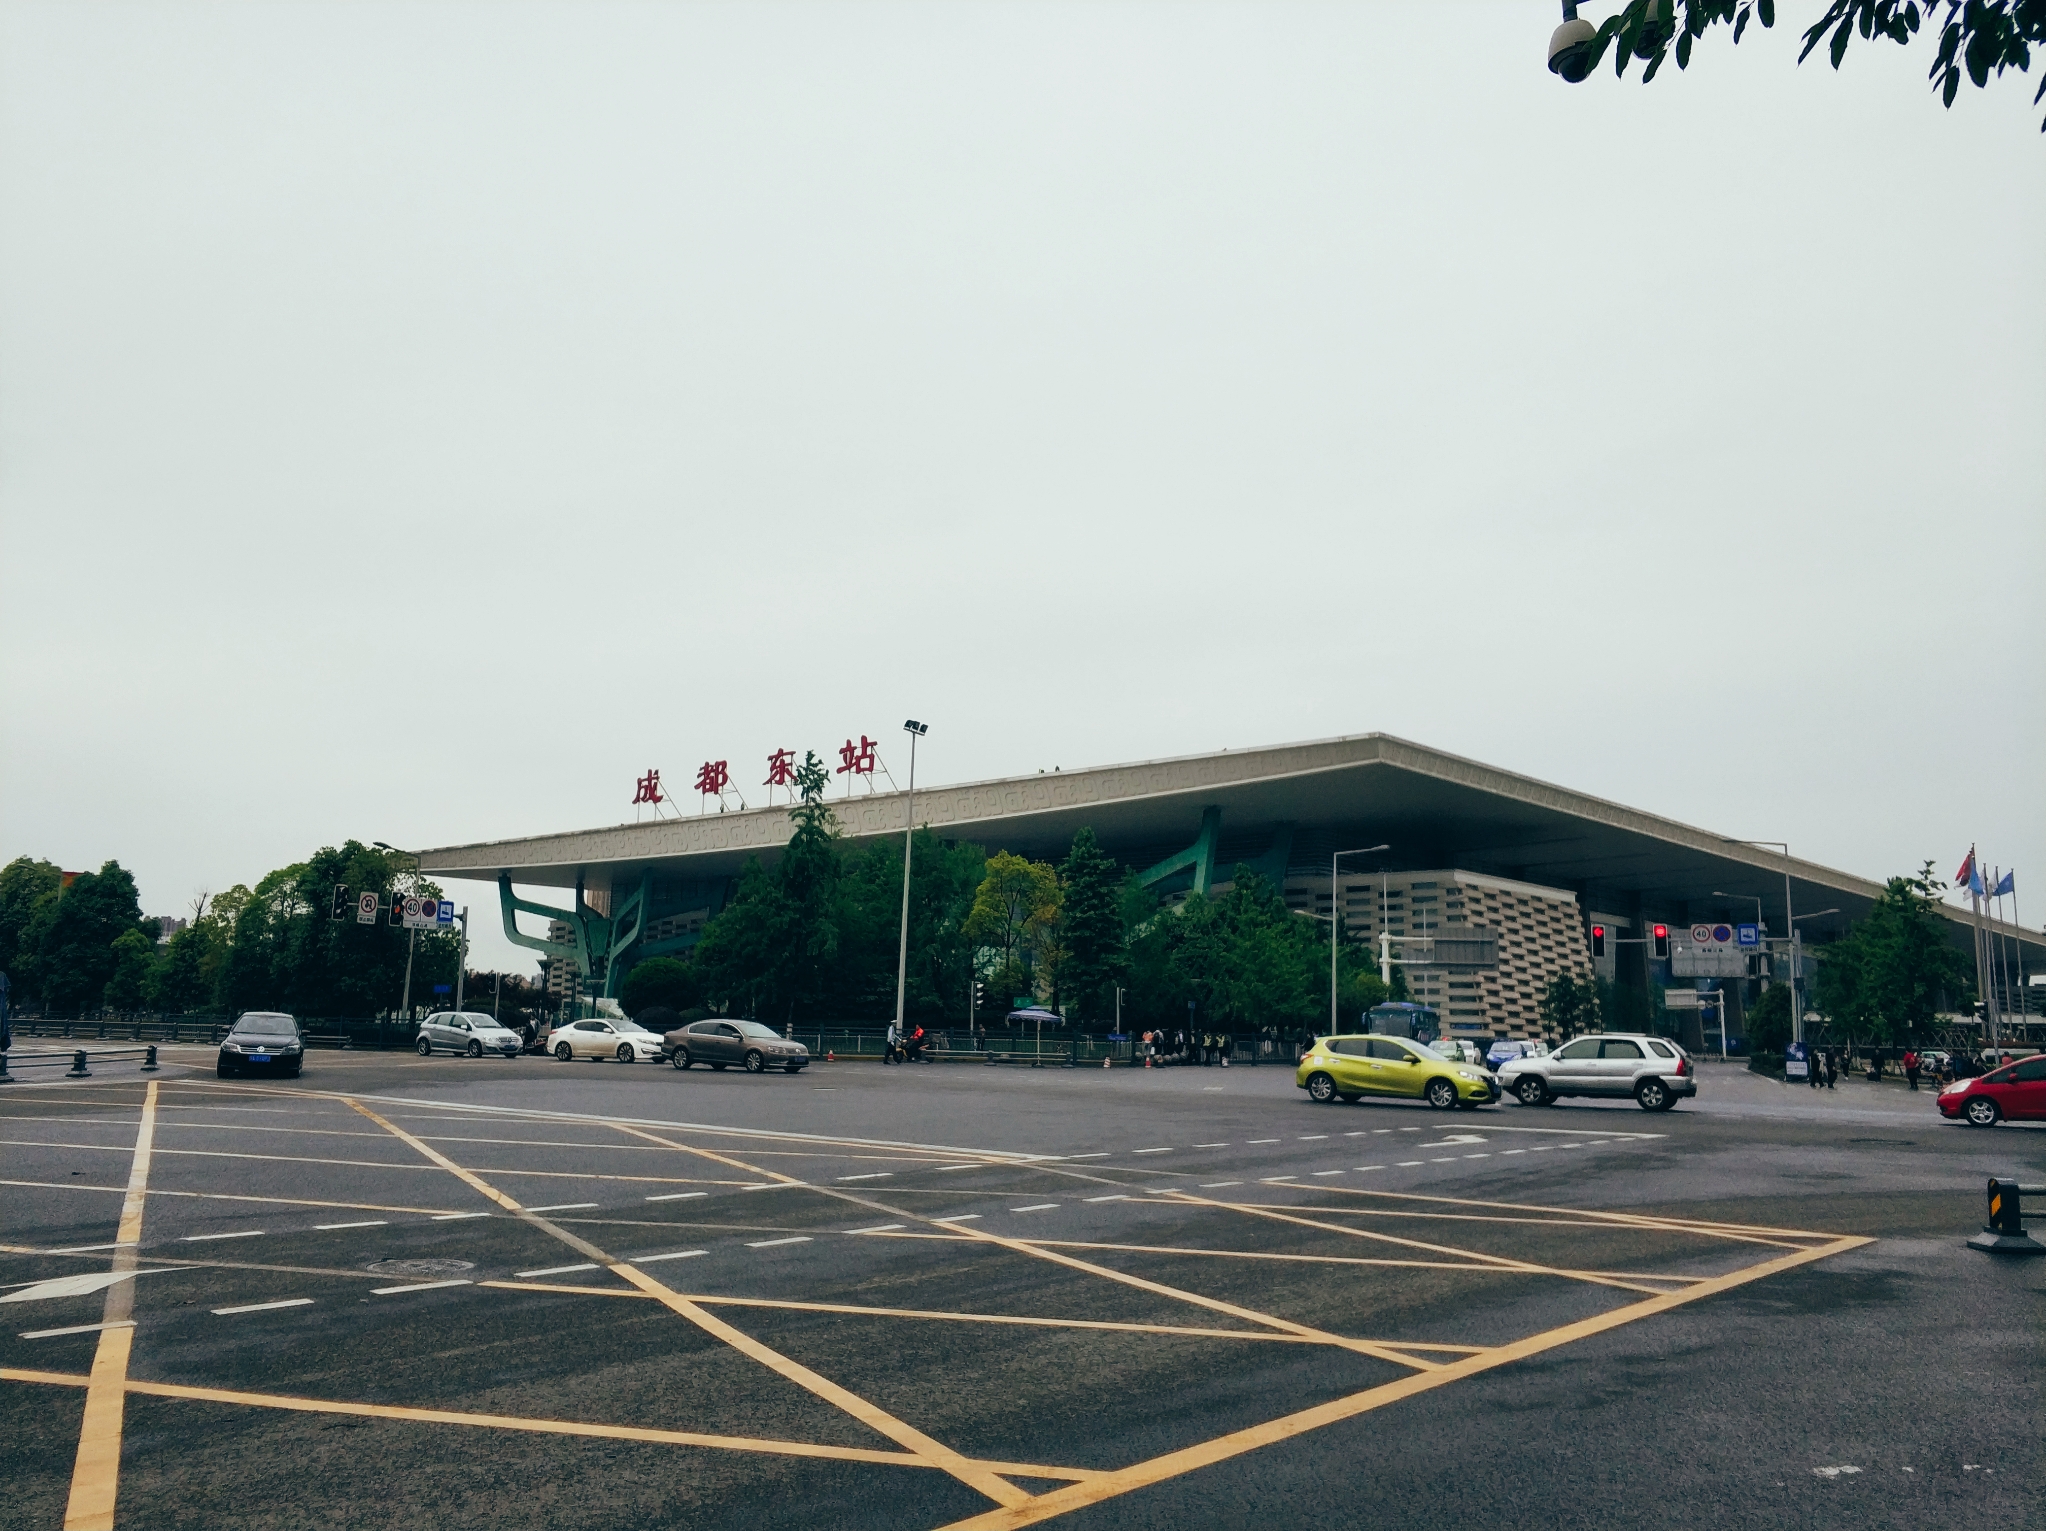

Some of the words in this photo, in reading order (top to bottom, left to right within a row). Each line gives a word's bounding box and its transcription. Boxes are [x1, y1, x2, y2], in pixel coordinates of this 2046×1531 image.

[632, 735, 877, 804] 成都东站
[407, 902, 418, 913] 40
[1696, 930, 1707, 938] 40
